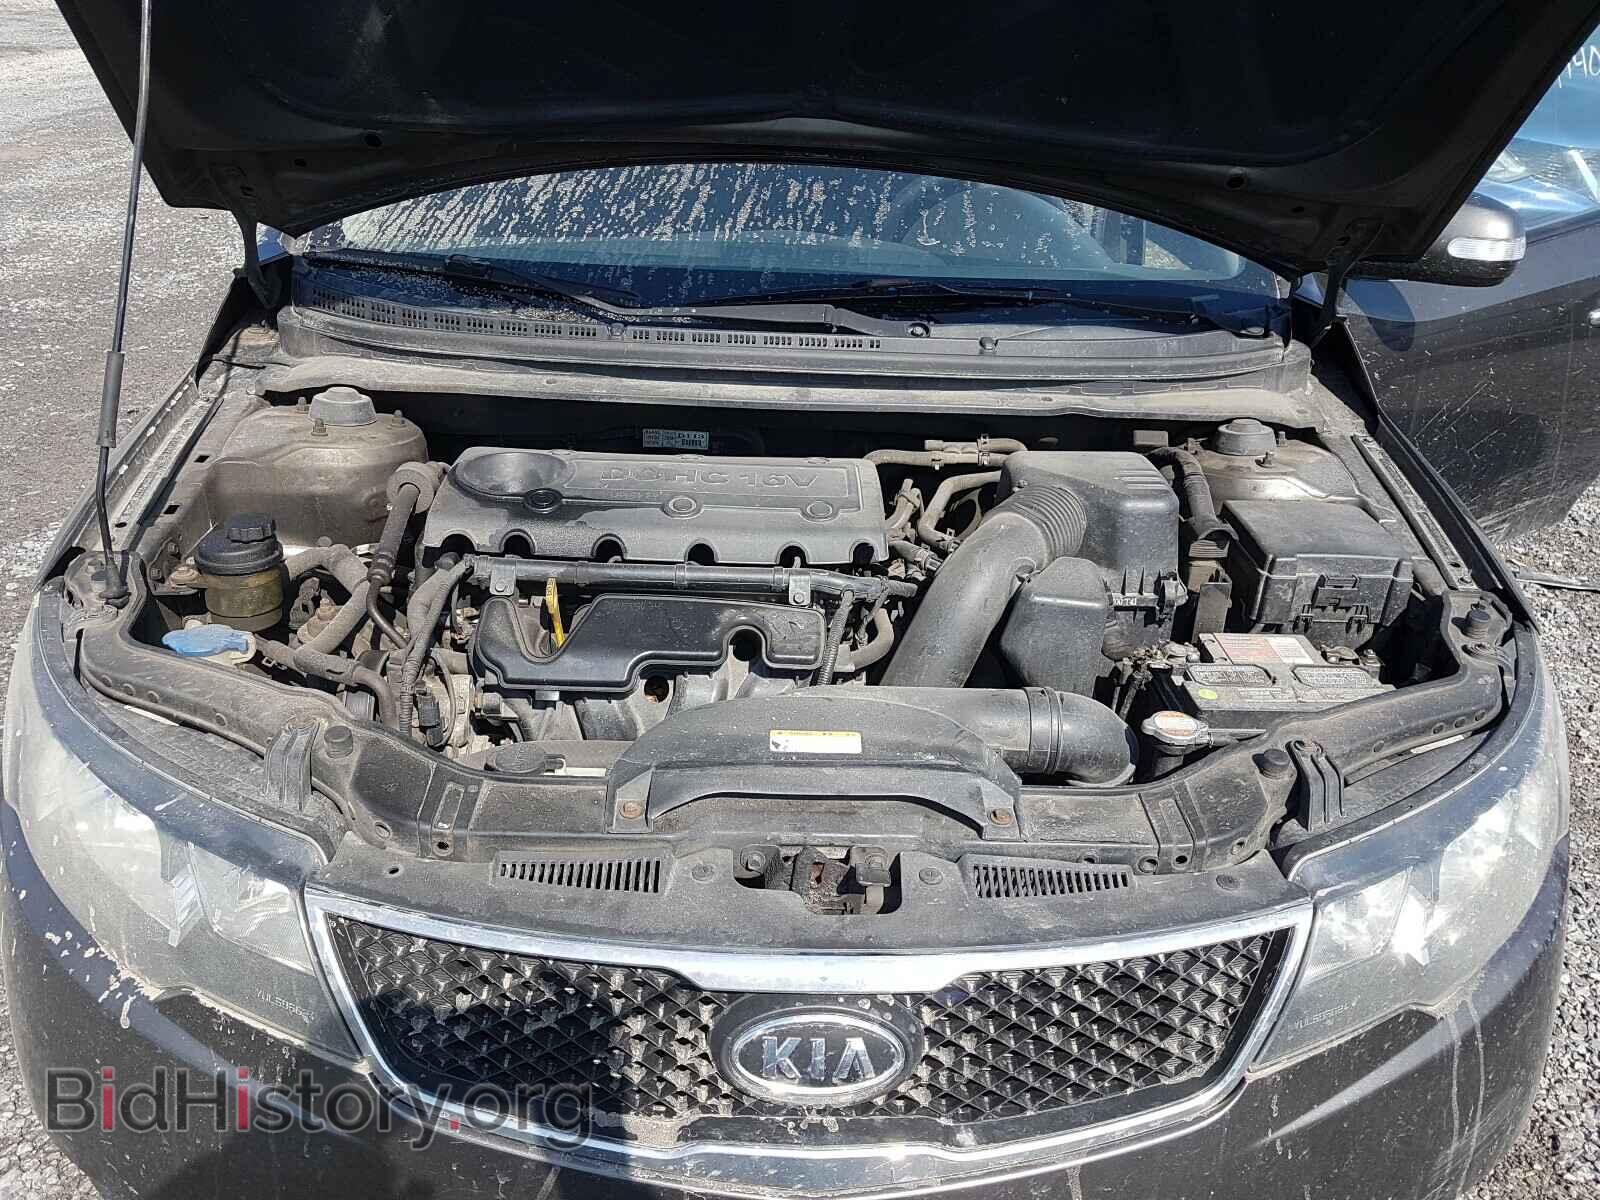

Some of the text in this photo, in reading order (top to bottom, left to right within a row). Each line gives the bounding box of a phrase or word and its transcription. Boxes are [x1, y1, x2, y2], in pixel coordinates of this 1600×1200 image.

[600, 467, 819, 489] DOHC 16V
[761, 1036, 875, 1084] KIA
